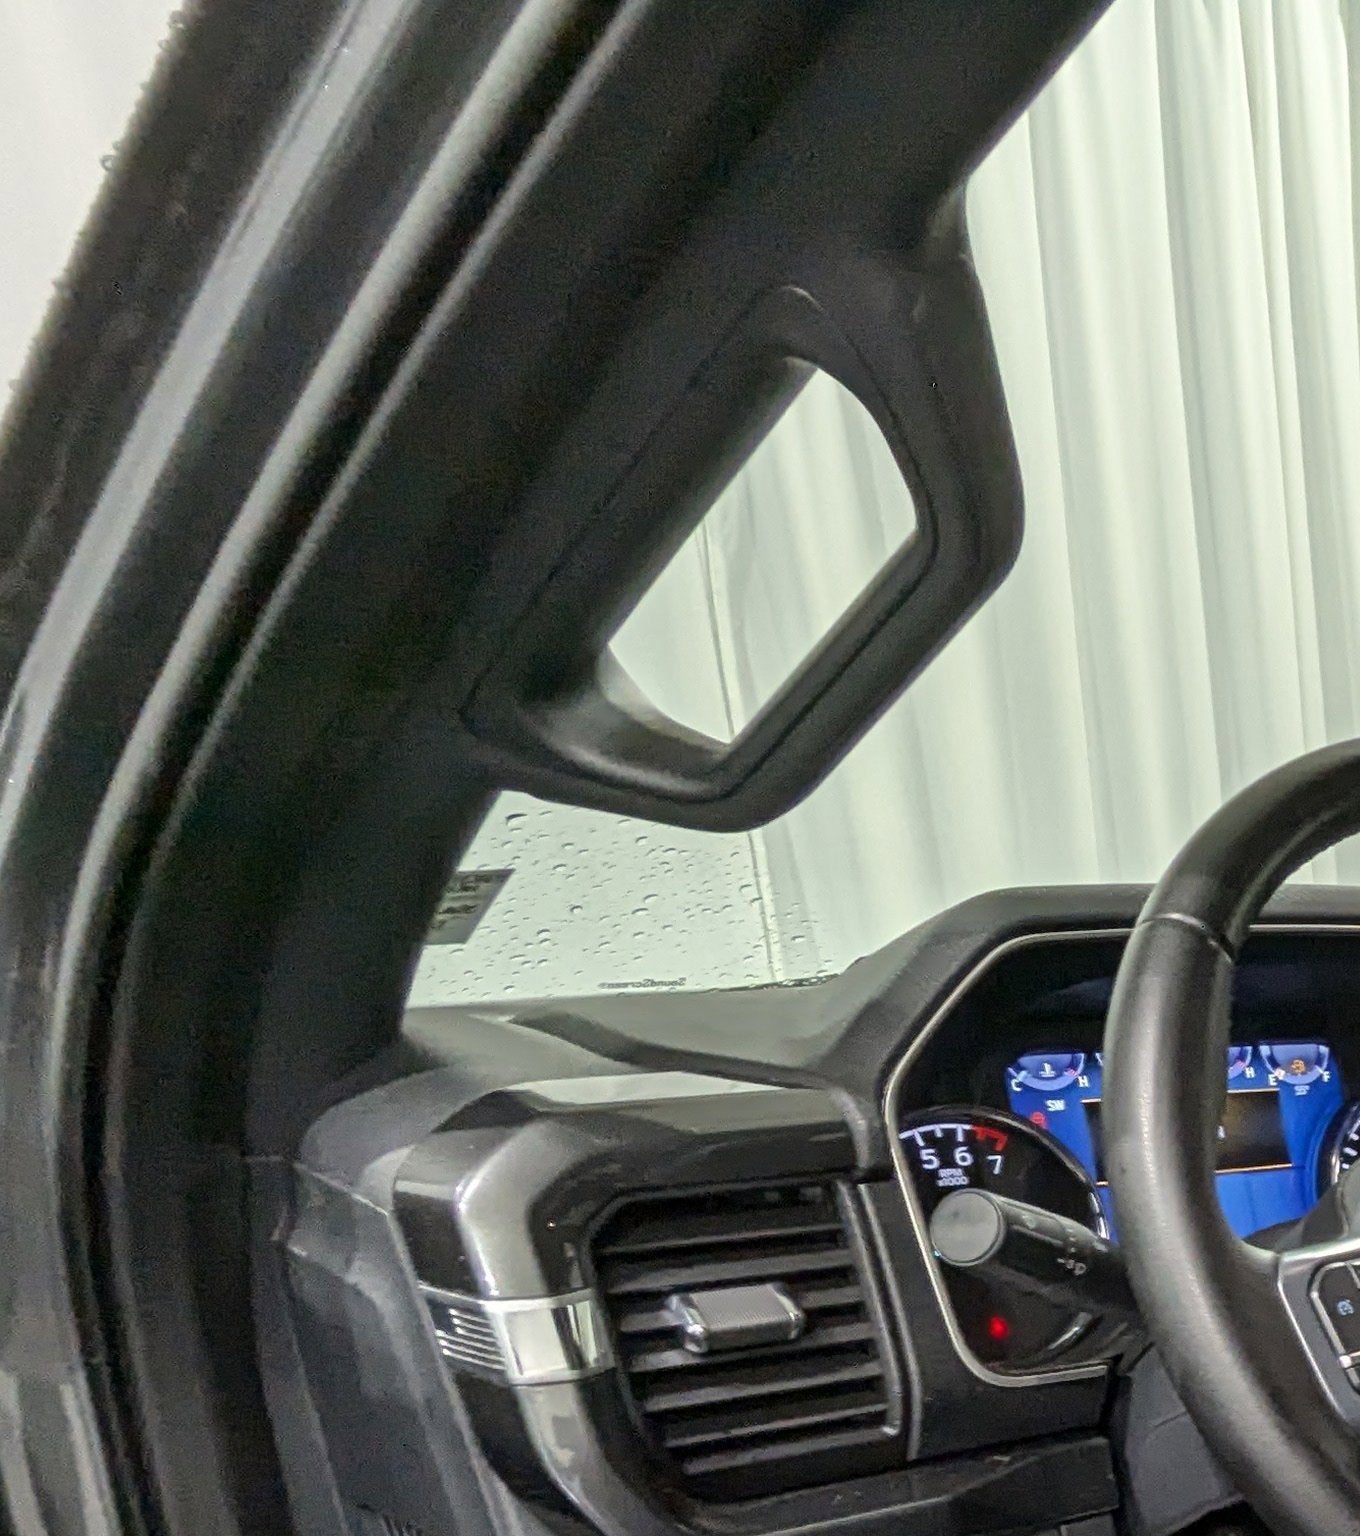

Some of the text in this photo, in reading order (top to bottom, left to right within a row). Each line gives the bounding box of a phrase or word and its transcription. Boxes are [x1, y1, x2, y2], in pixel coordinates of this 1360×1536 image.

[920, 1148, 940, 1170] 5
[953, 1146, 974, 1167] 6
[986, 1154, 1005, 1175] 7
